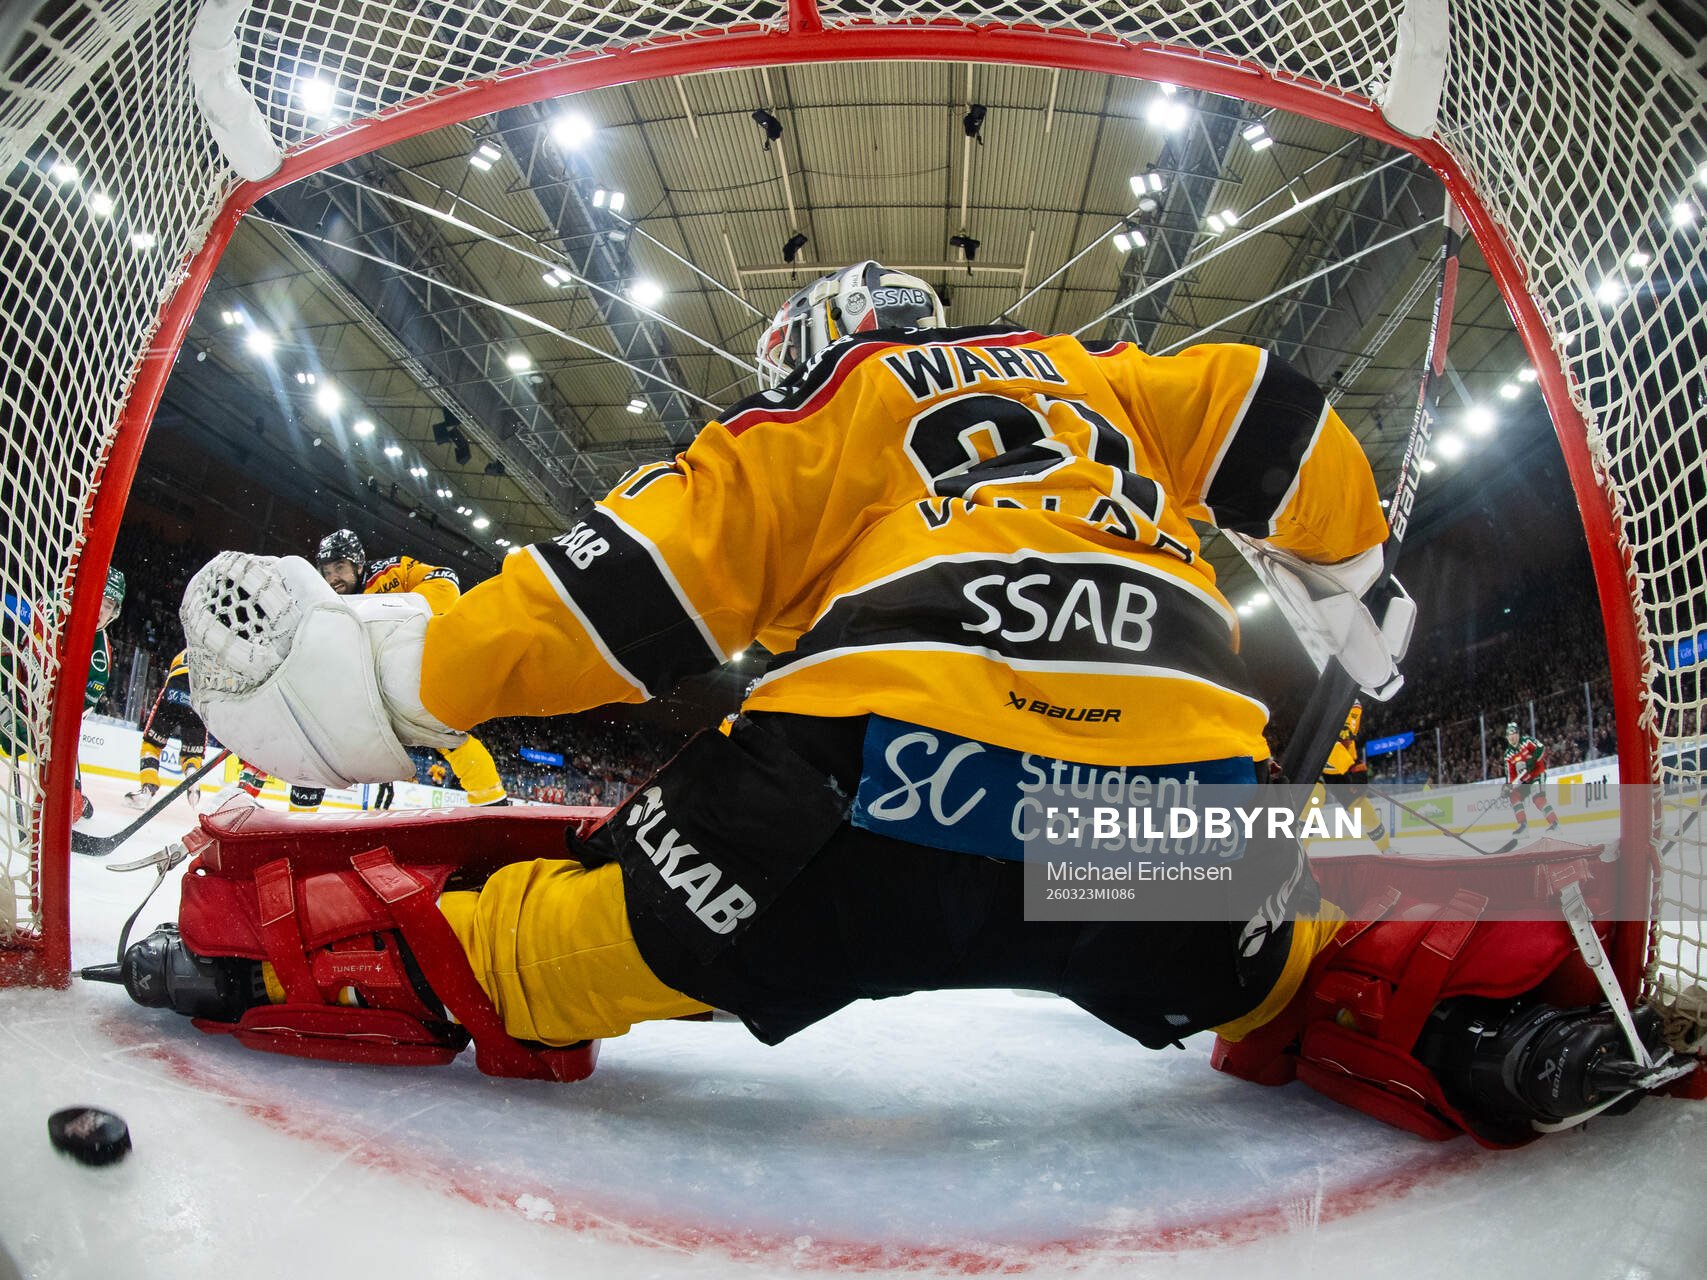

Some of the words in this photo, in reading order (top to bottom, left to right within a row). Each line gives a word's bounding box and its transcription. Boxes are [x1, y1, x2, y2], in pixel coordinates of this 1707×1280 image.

[872, 288, 926, 308] SSAB
[881, 345, 1068, 403] WARD
[961, 573, 1158, 651] SSAB
[1016, 752, 1199, 811] Student
[634, 809, 757, 935] LKAB
